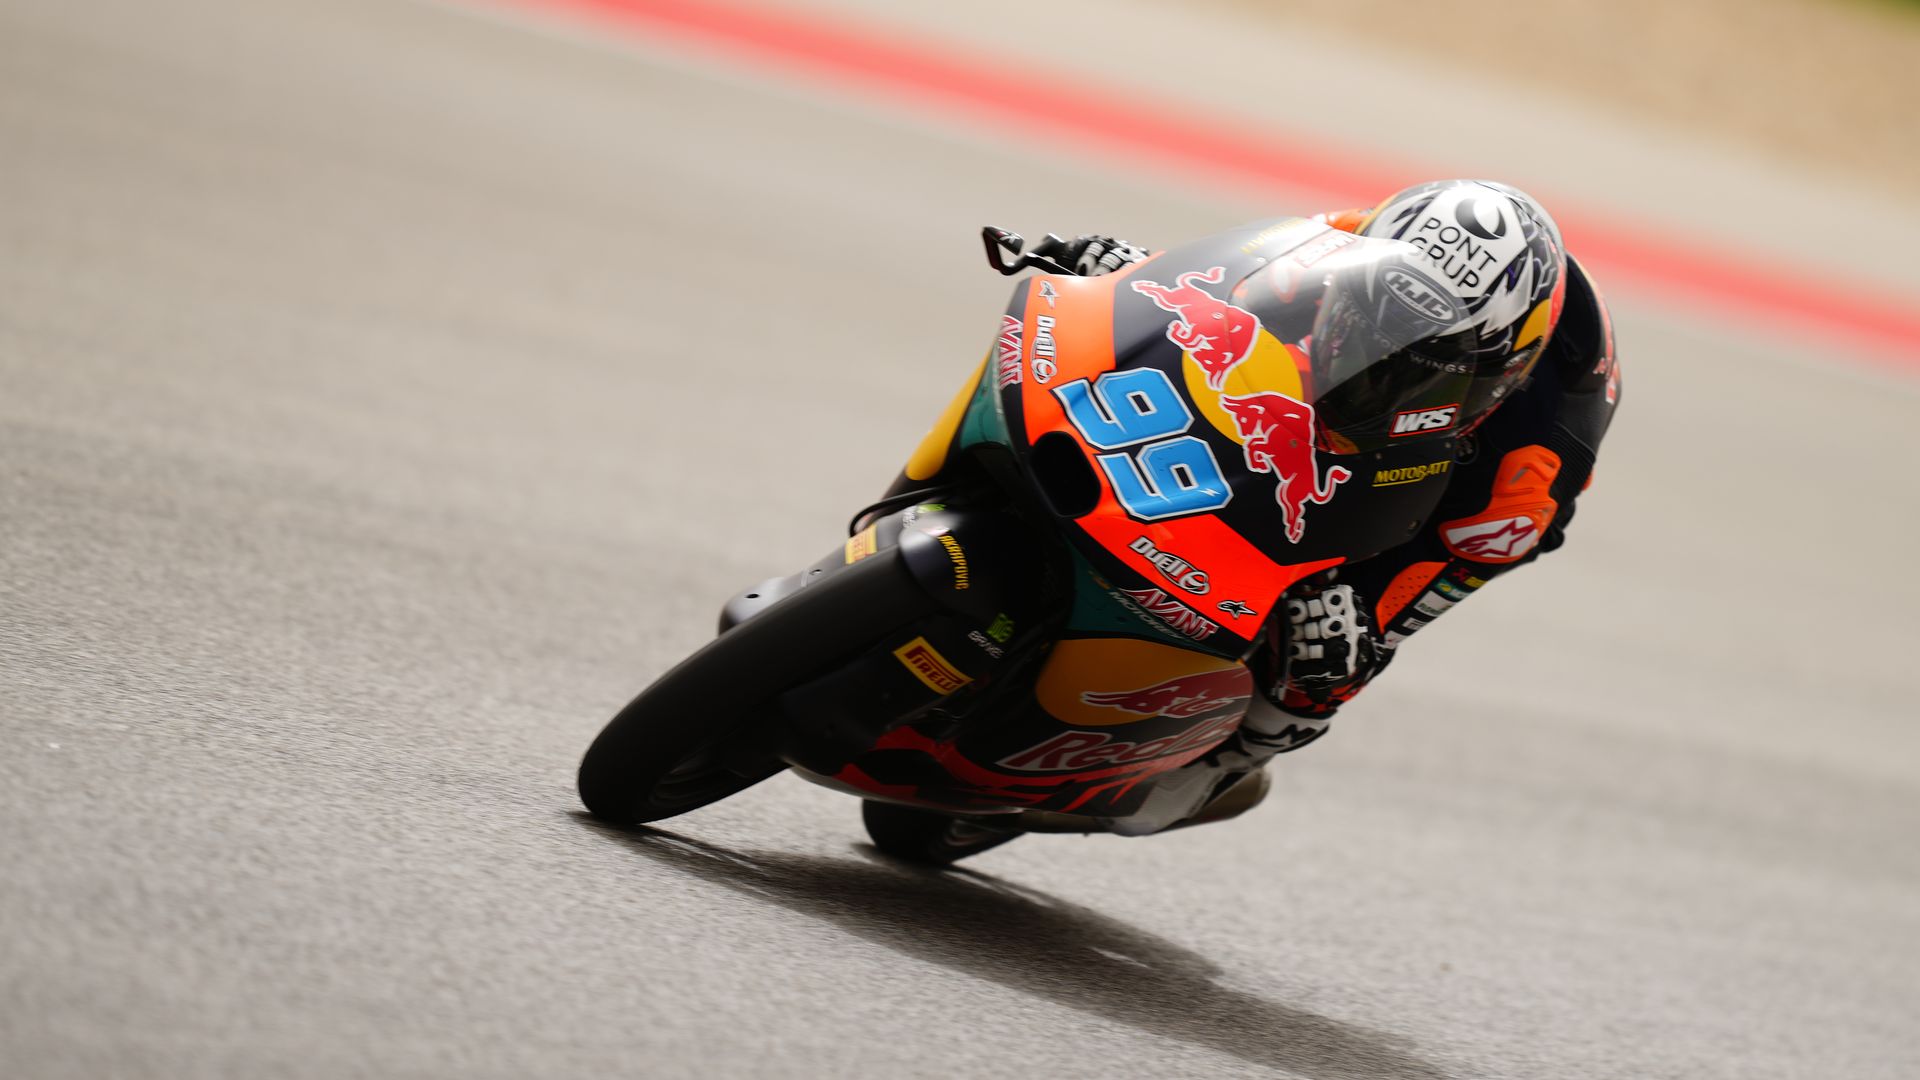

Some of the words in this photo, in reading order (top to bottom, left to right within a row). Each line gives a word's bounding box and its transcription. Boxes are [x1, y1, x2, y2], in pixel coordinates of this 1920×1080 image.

[1418, 216, 1498, 271] PONT
[1387, 273, 1451, 317] HJC
[1393, 406, 1457, 434] WRS
[1051, 366, 1235, 524] 99
[1372, 460, 1452, 484] MOTOBATT
[1118, 587, 1220, 641] AVANT
[902, 644, 965, 692] PIRELLI
